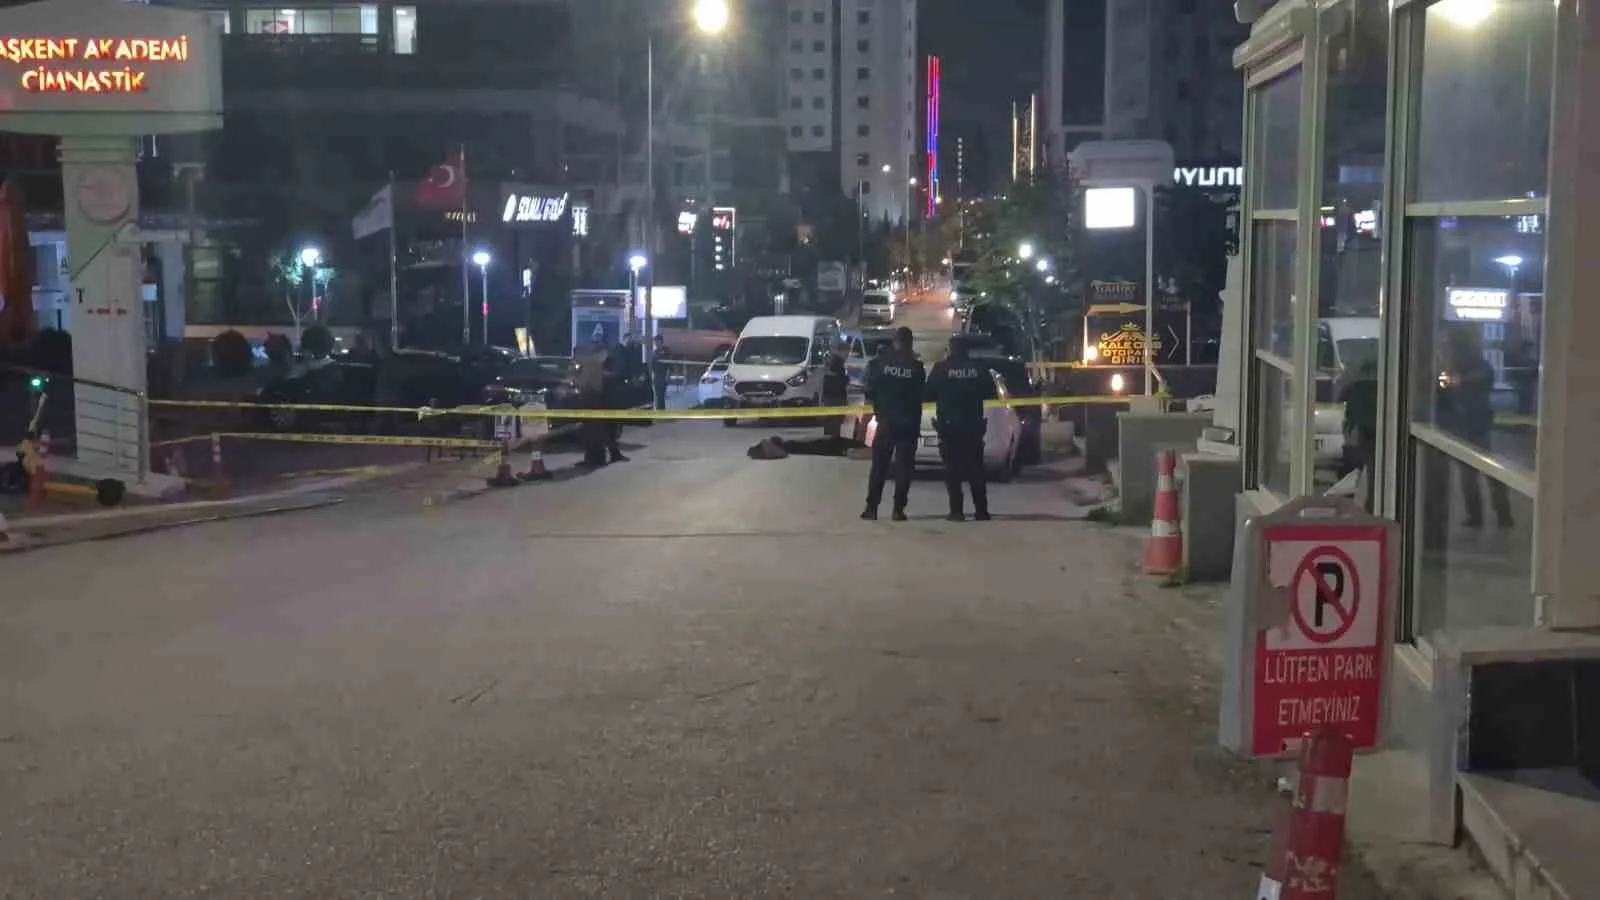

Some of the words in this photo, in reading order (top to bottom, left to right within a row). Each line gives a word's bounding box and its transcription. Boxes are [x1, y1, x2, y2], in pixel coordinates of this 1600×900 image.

[84, 35, 189, 61] AKADEMİ
[1263, 652, 1330, 684] LÜTFEN
[1334, 653, 1376, 681] PARK
[1277, 689, 1361, 725] ETMEYİNİZ
